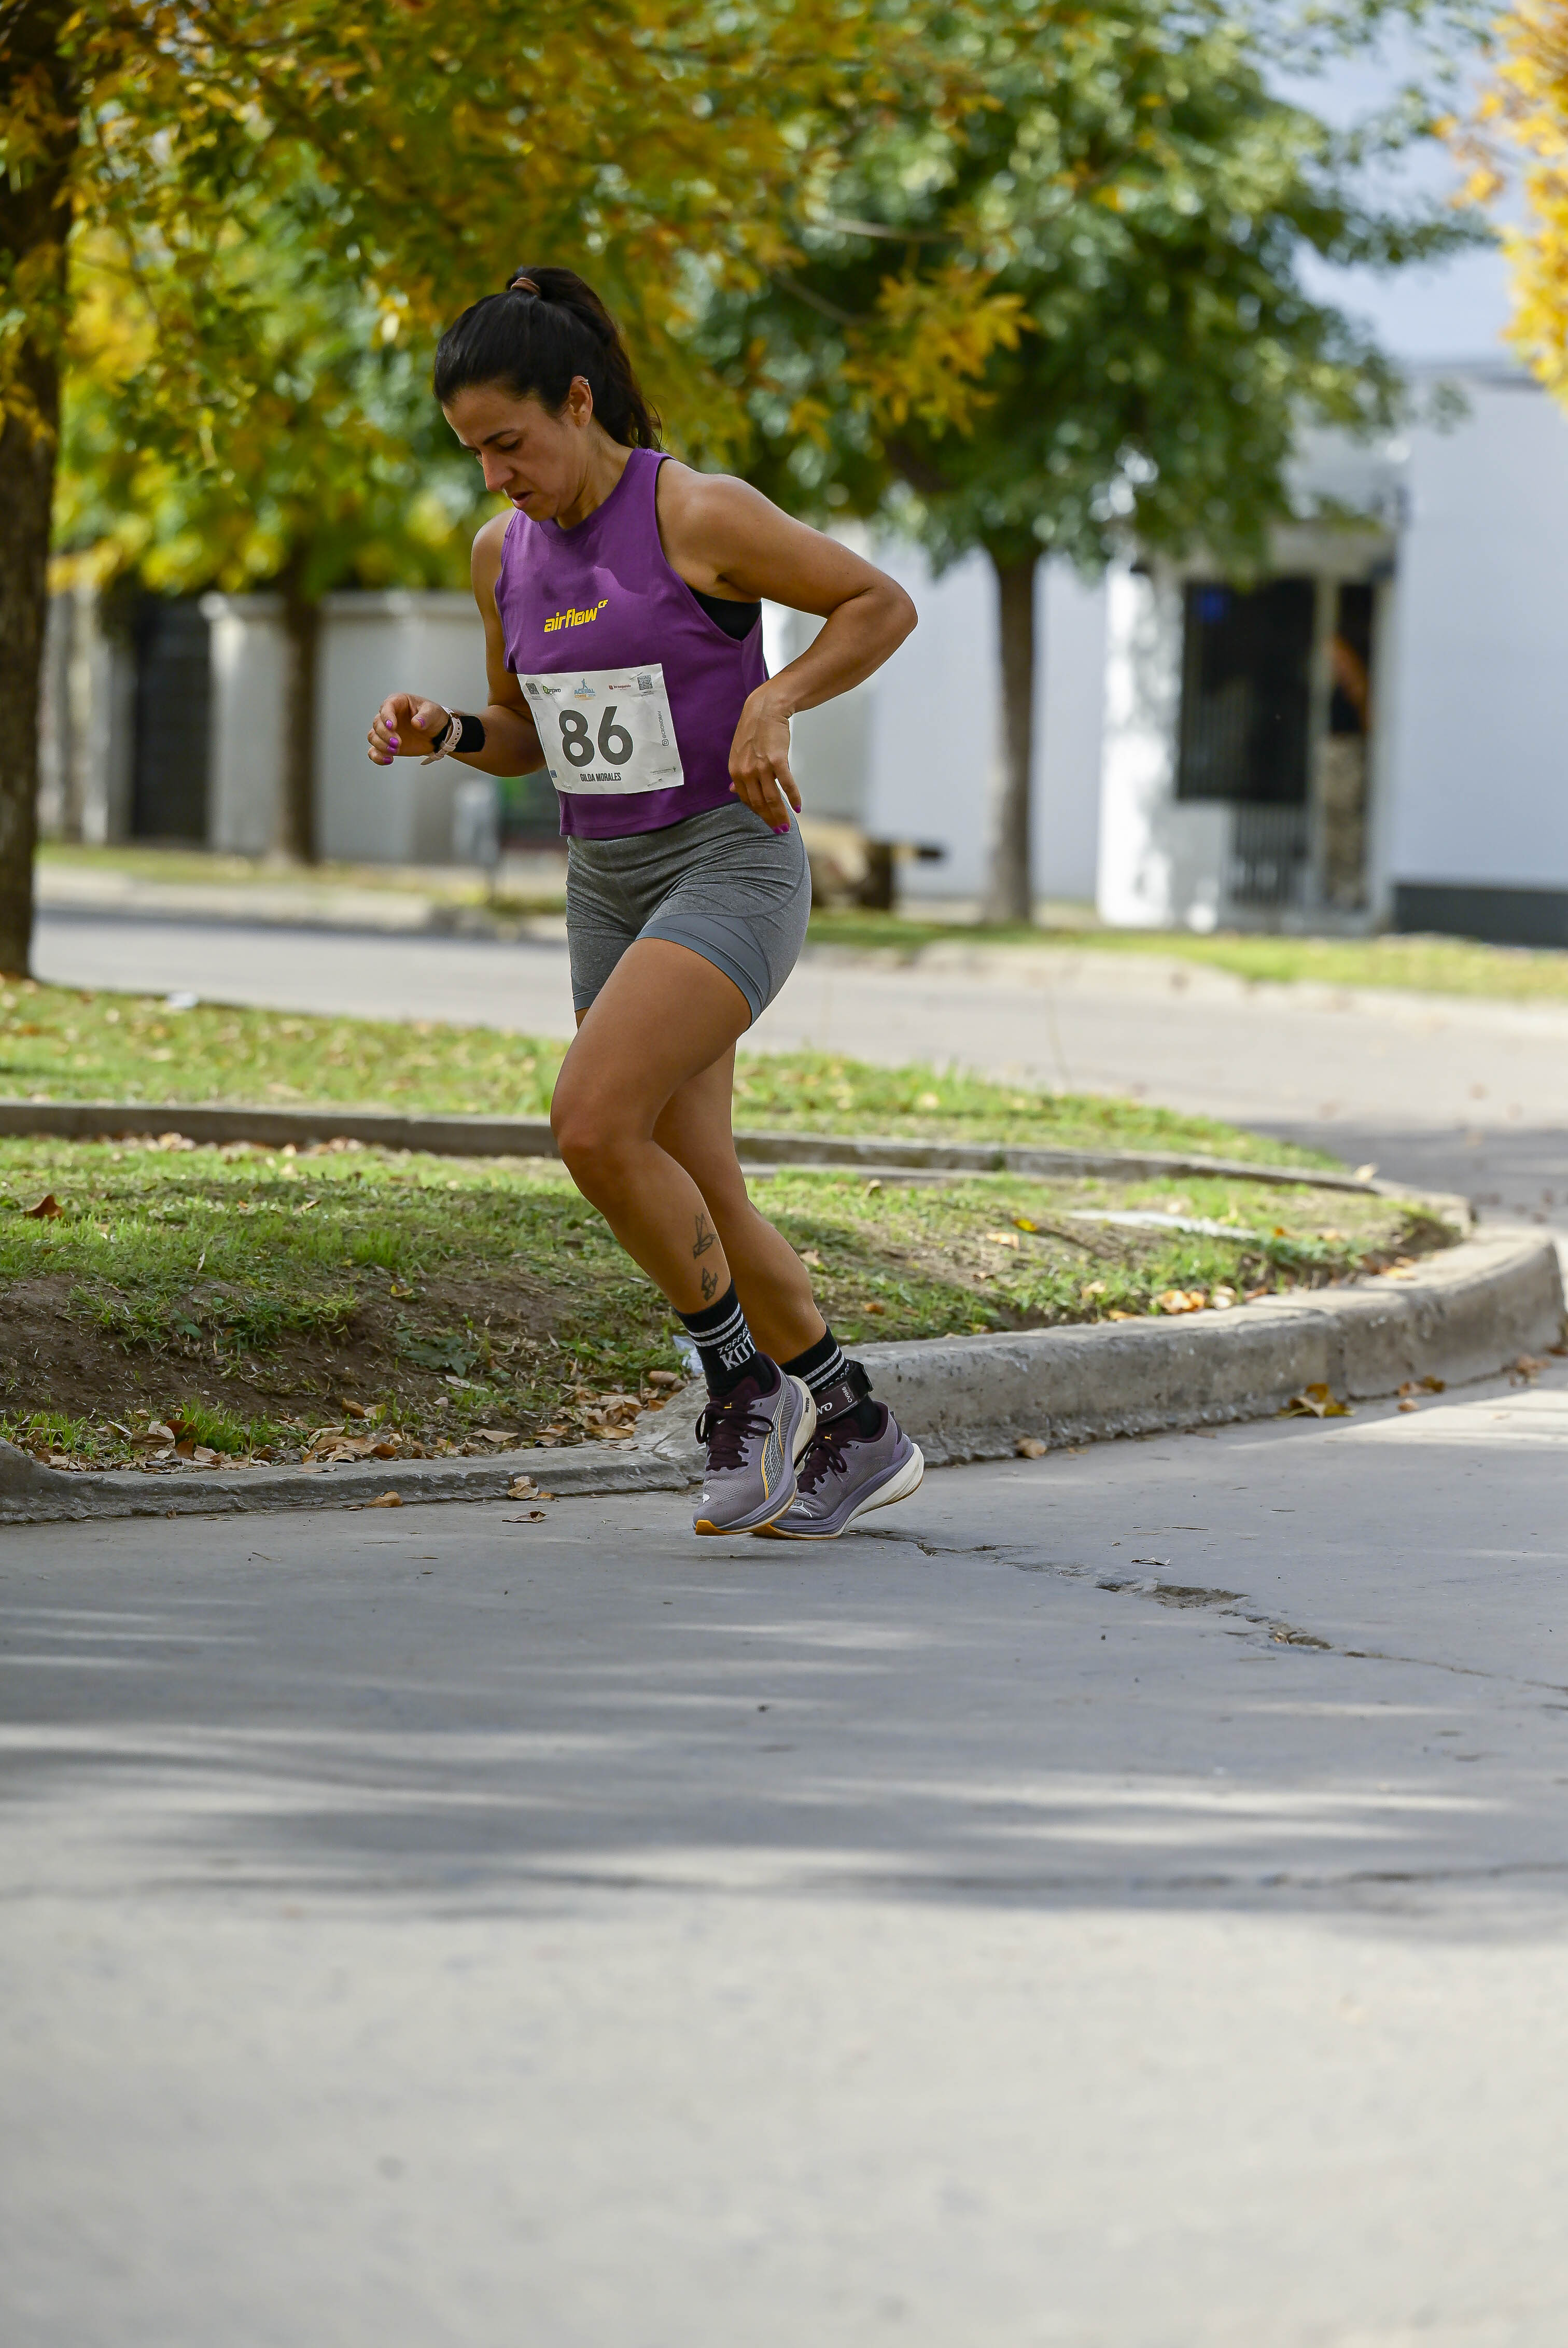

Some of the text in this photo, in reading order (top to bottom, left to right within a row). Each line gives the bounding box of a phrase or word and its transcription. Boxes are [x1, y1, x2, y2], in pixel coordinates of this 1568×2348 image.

[544, 607, 598, 633] airflow
[558, 706, 634, 767] 86
[580, 772, 622, 782] GILDA MORALES
